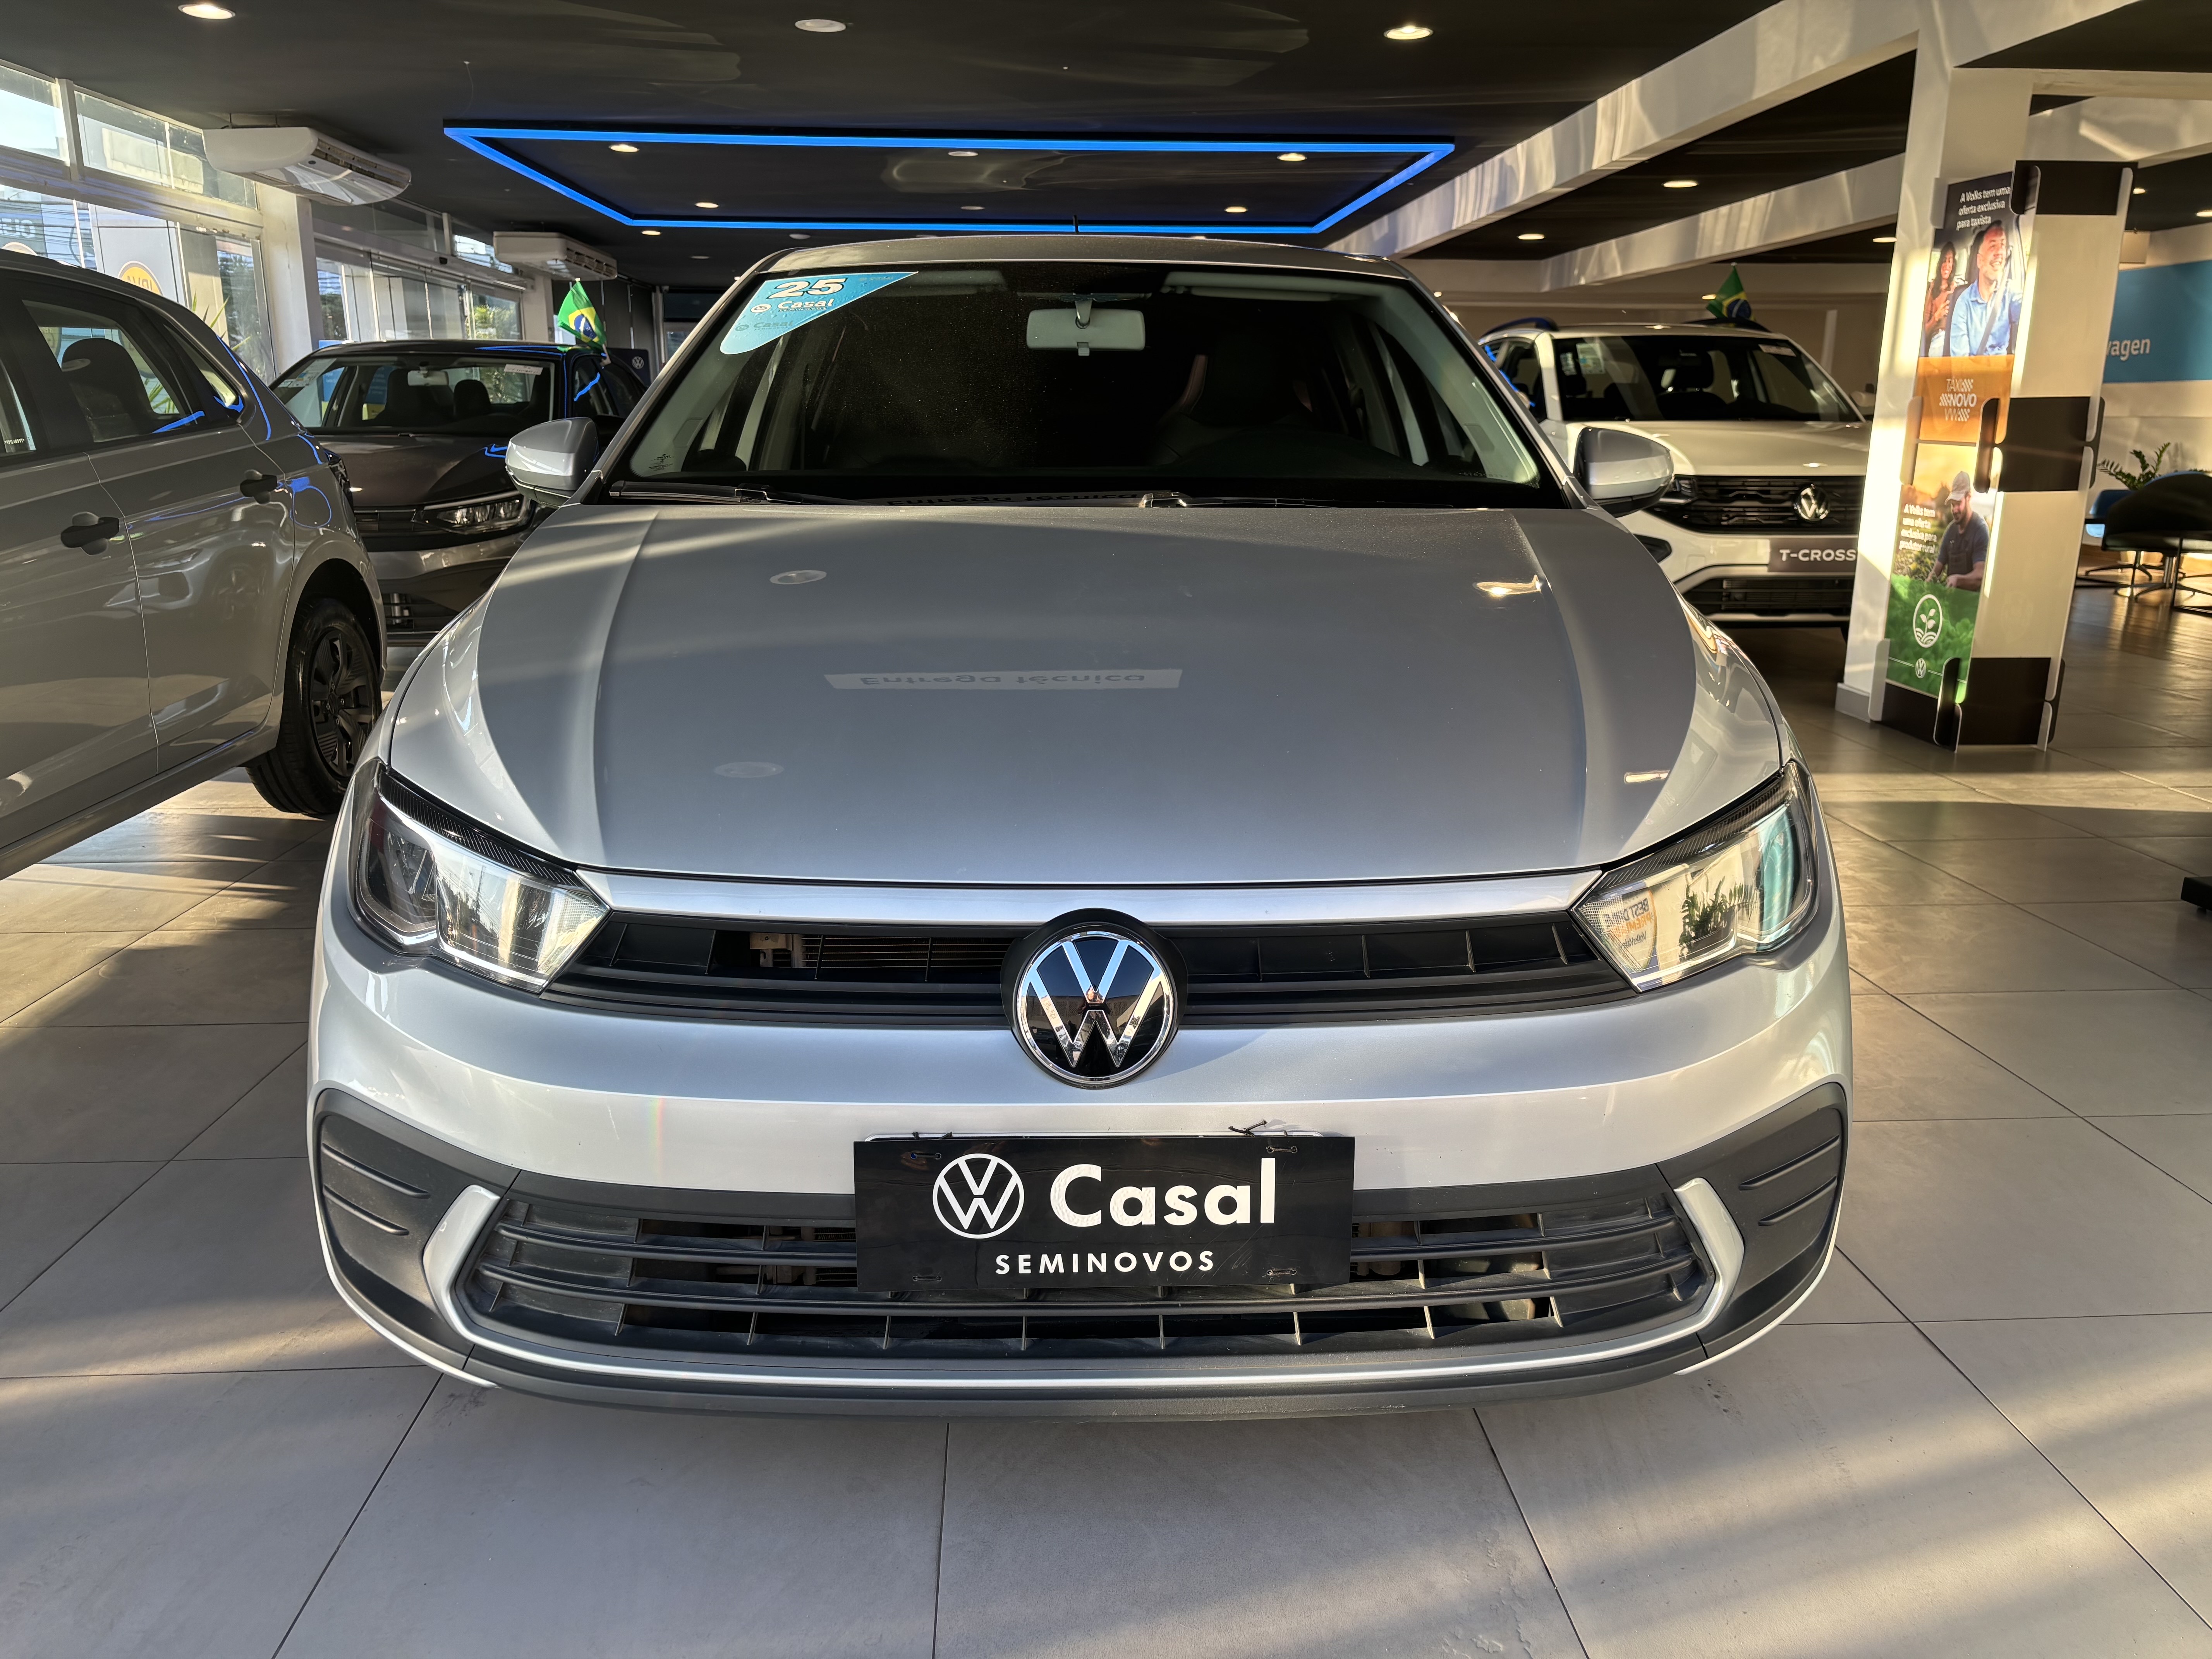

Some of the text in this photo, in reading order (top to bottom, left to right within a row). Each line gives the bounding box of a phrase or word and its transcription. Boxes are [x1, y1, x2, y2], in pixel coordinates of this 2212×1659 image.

[766, 278, 848, 299] 25
[778, 299, 834, 309] Casal
[1948, 393, 1977, 407] NOVO
[1779, 549, 1856, 561] T-CROSS
[1050, 1157, 1276, 1228] Casal
[995, 1250, 1214, 1275] SEMINOVOS
